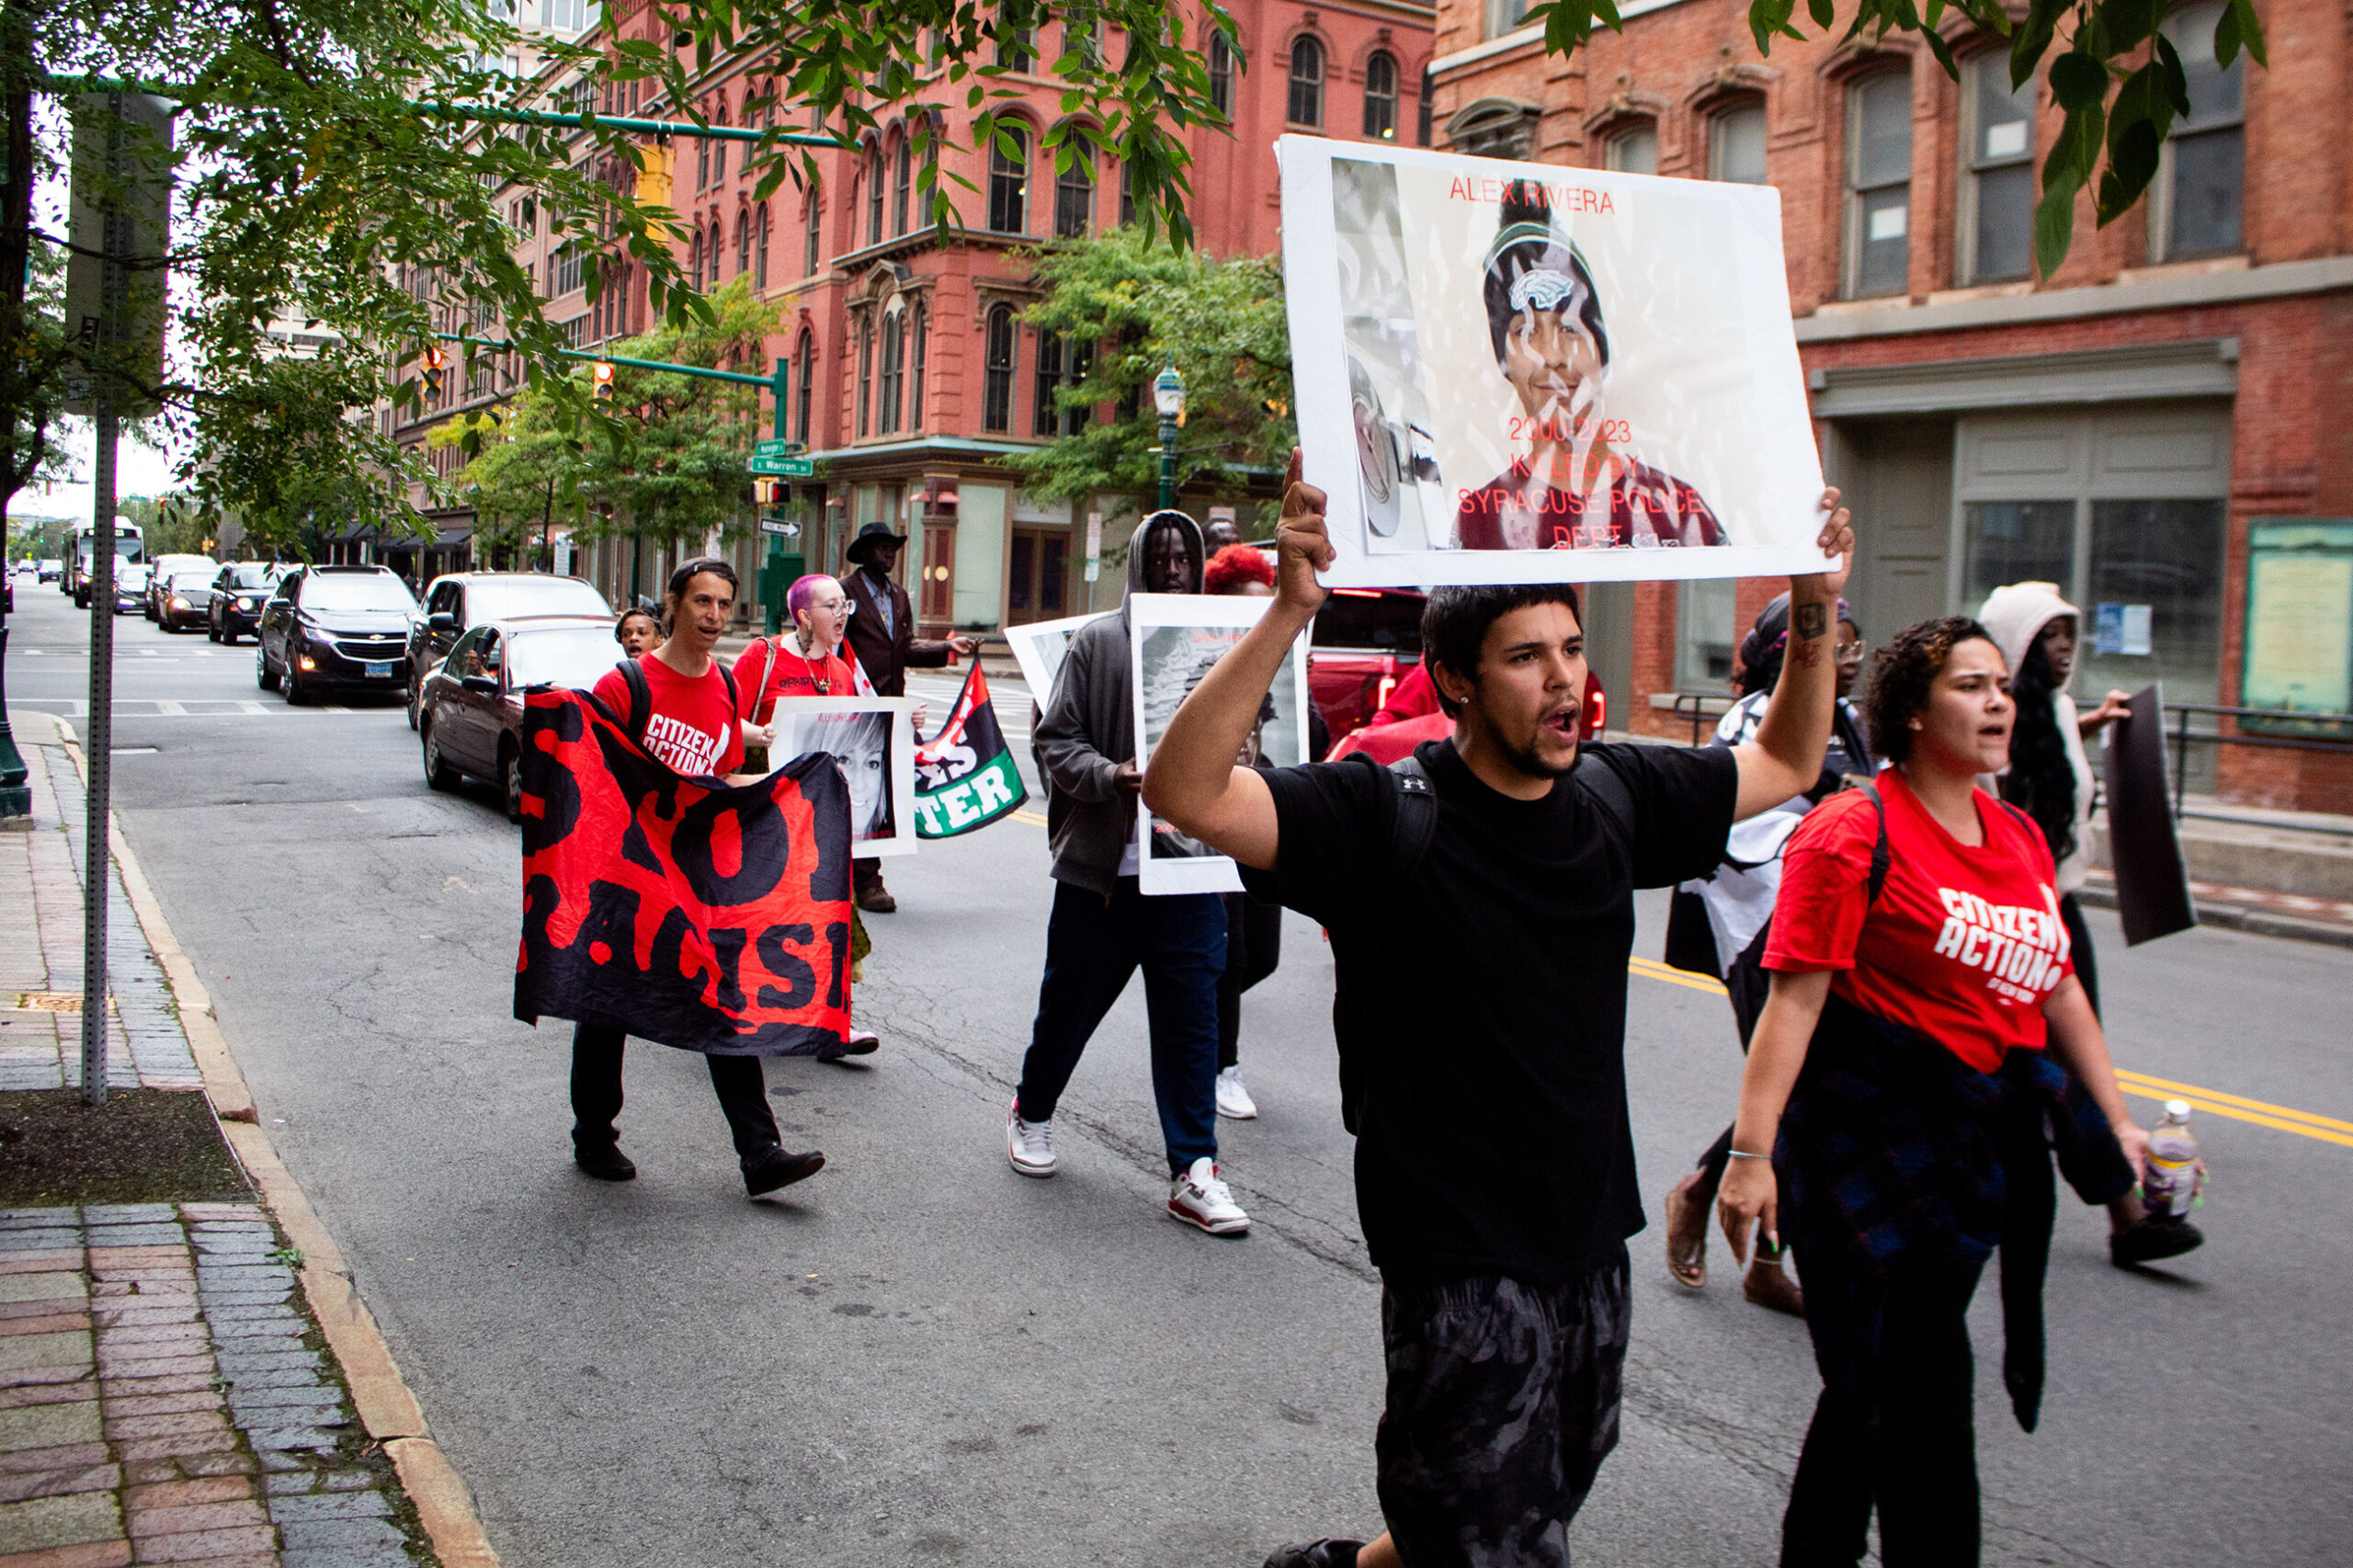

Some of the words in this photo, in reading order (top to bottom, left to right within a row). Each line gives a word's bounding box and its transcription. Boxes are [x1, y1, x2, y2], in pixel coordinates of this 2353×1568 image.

[1449, 176, 1517, 205] ALEX
[1523, 180, 1615, 215] RIVERA
[1509, 417, 1631, 443] 2000-2023
[766, 460, 797, 471] Warren
[1510, 453, 1601, 478] KILLED
[1608, 454, 1639, 477] BY
[1458, 489, 1604, 514] SYRACUSE
[1610, 490, 1702, 513] POLICE
[1553, 525, 1622, 550] DEPT
[647, 713, 715, 757] CITIZEN
[1938, 887, 2059, 953] CITIZEN
